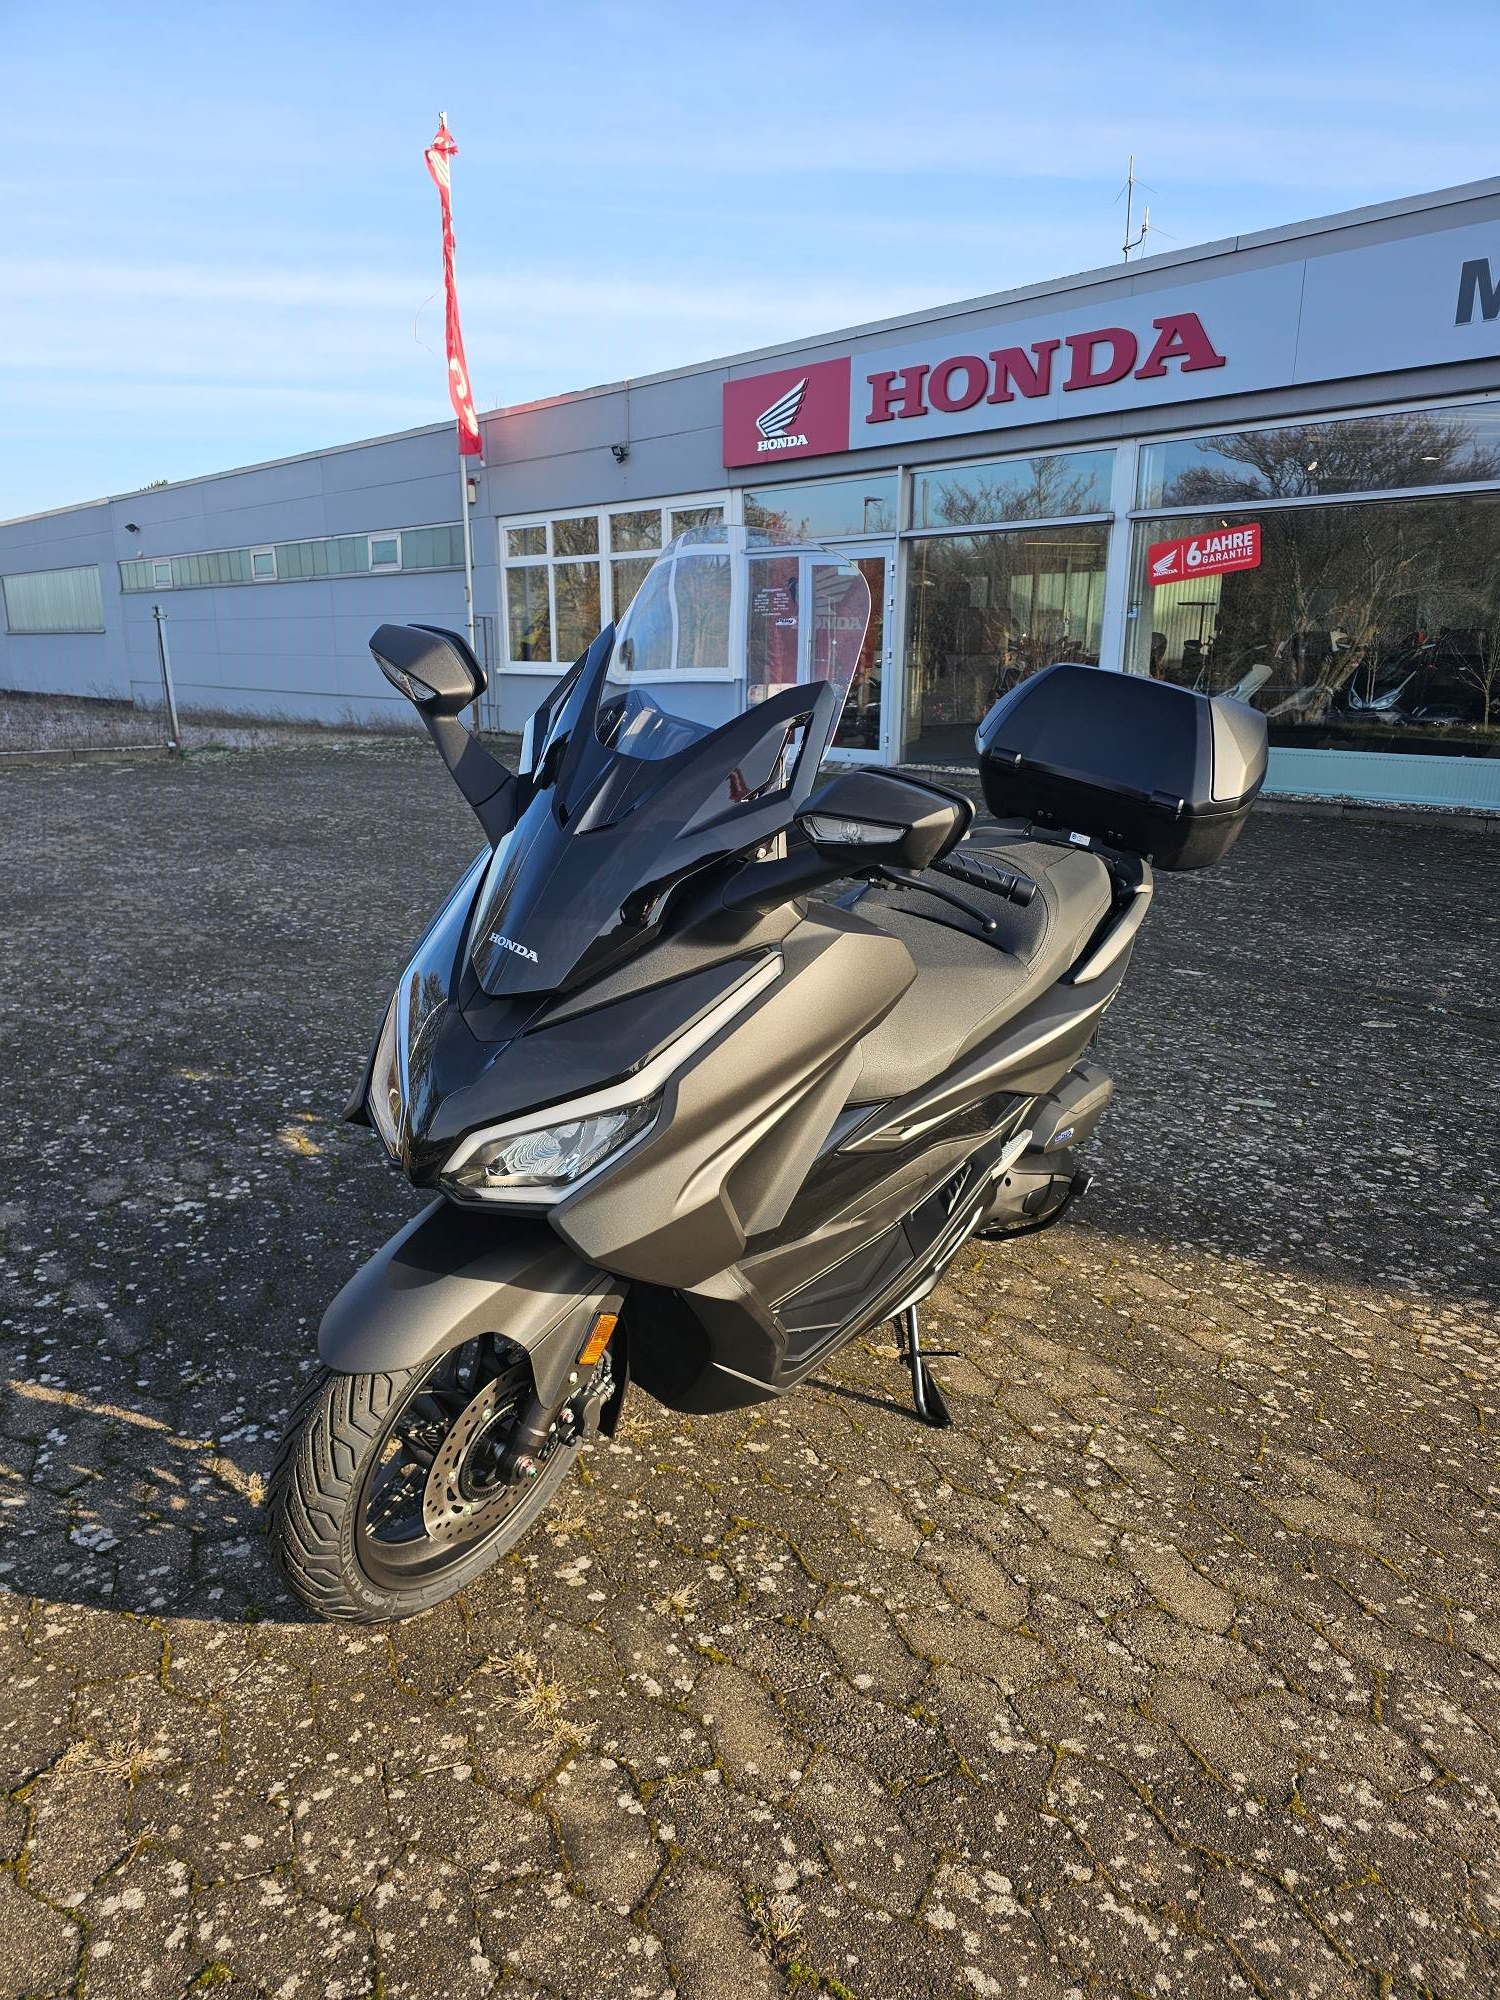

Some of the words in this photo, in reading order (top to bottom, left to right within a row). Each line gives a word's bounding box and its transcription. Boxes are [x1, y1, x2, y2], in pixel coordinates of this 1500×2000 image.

[865, 312, 1226, 424] HONDA
[757, 434, 808, 452] HONDA
[1186, 541, 1202, 566] 6
[1202, 546, 1253, 564] GARANTIE
[1153, 569, 1178, 577] HONDA
[488, 932, 539, 963] HONDA
